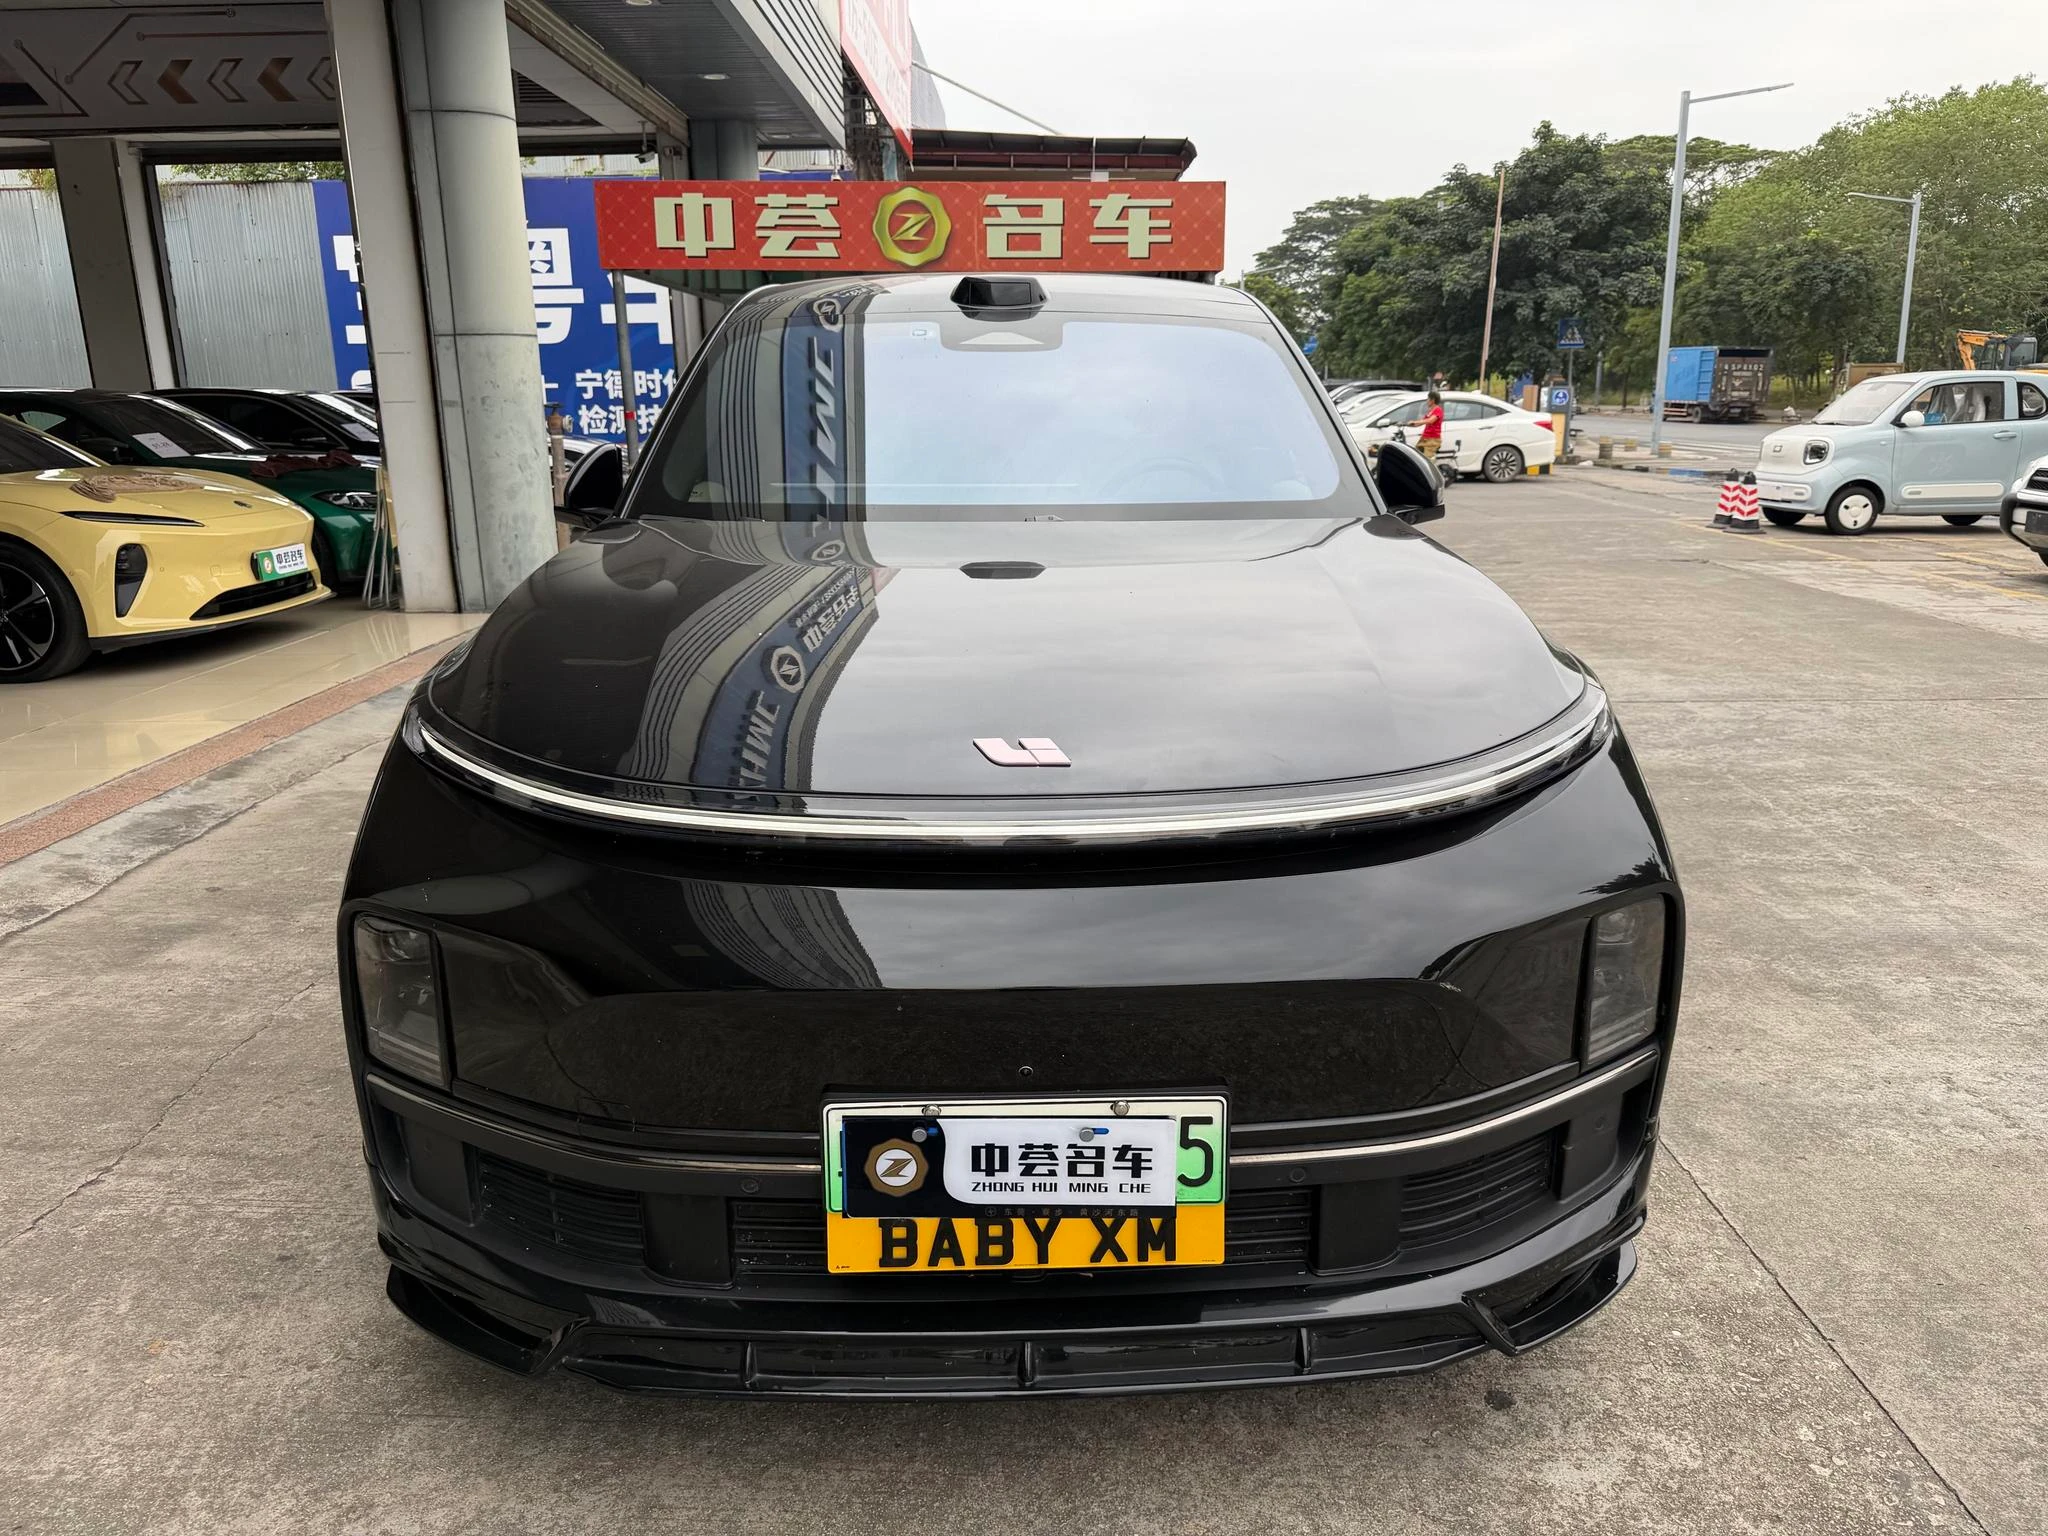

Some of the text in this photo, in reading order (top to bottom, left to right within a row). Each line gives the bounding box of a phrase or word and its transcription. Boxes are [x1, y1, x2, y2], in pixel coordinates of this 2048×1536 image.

[653, 192, 841, 259] 中荟
[983, 192, 1174, 259] 名车
[970, 1142, 1154, 1180] 中荟名车
[971, 1181, 1151, 1195] ZHONG HUI MING CHE
[878, 1217, 1176, 1267] BABY XM
